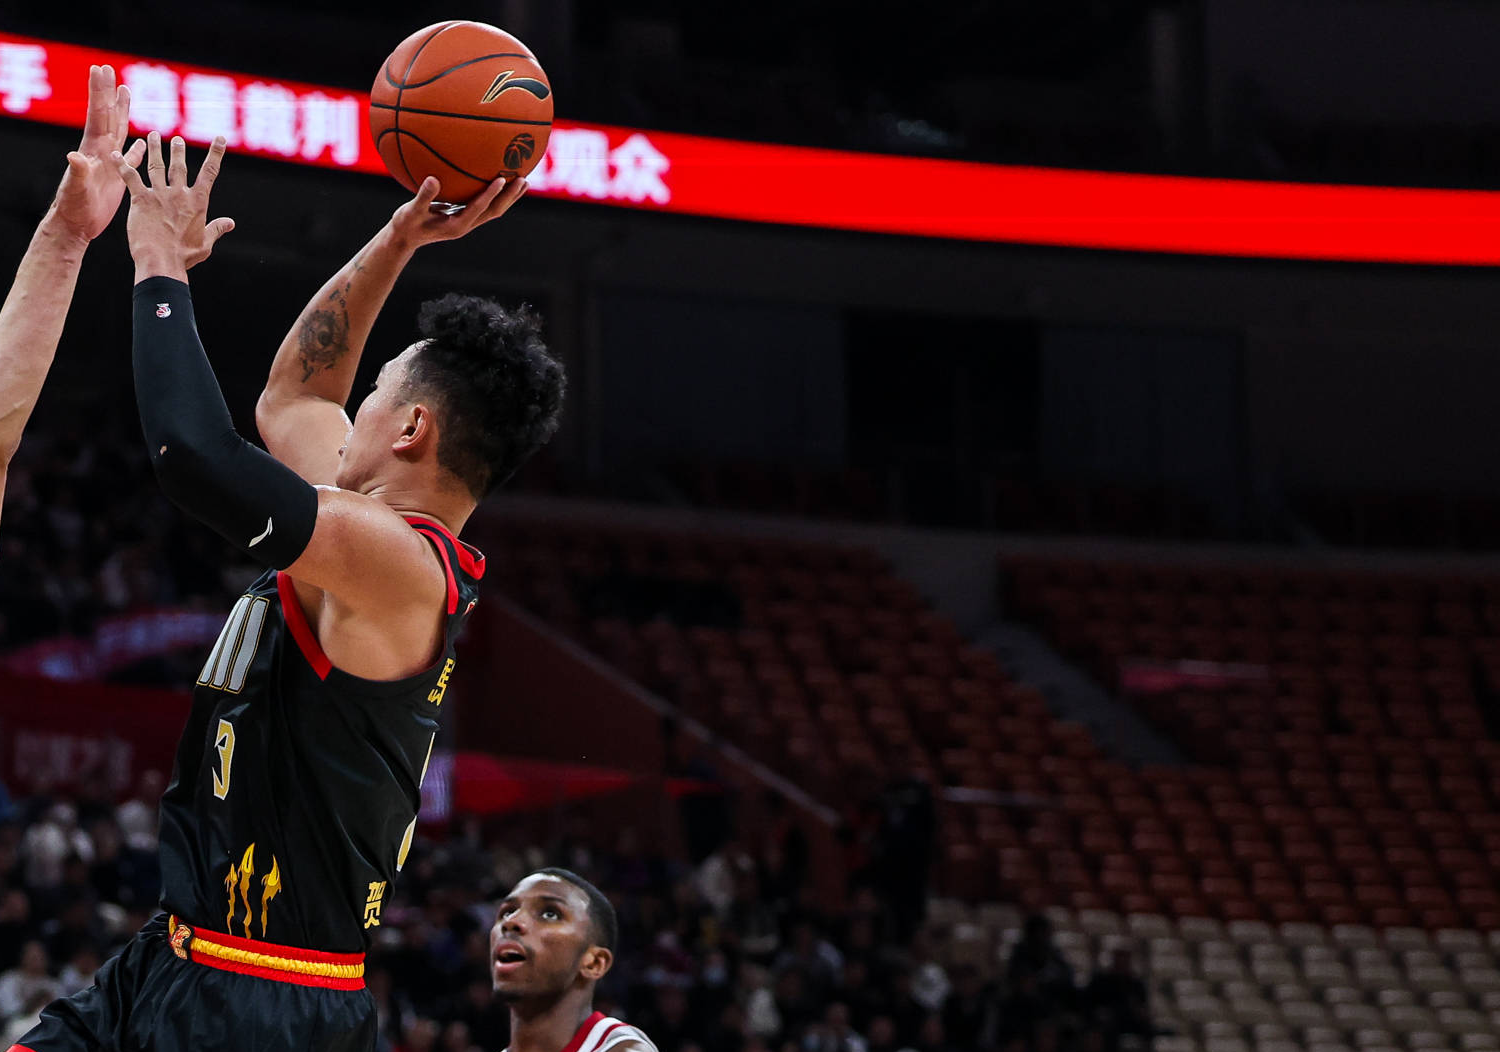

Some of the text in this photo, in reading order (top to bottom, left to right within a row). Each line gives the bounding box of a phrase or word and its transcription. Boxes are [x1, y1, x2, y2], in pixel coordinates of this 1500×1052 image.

[121, 61, 360, 166] 尊重裁判
[525, 128, 671, 205] 观众
